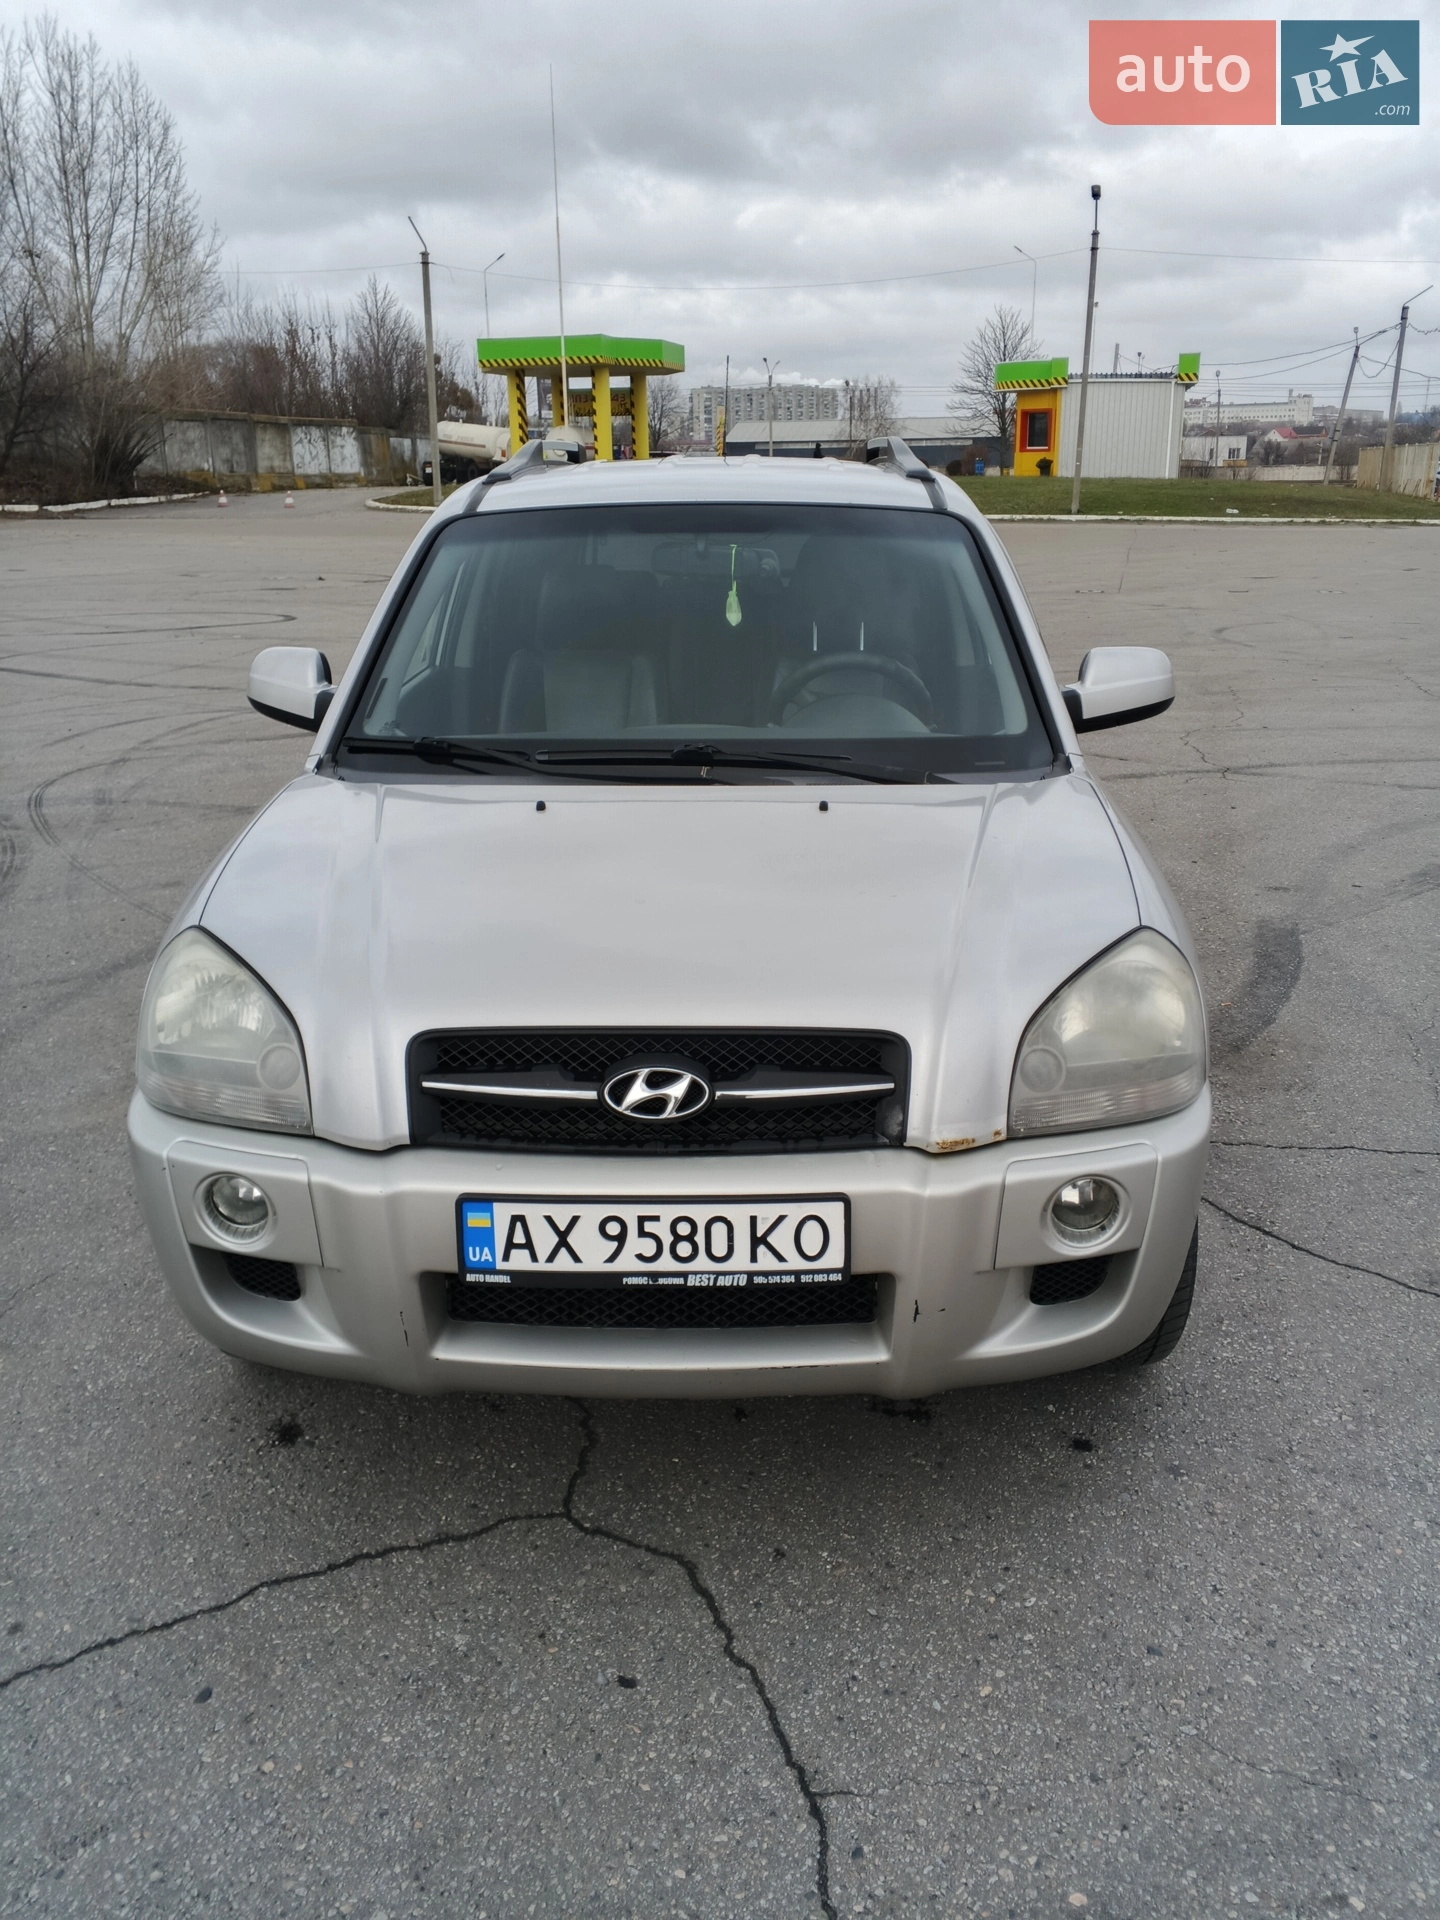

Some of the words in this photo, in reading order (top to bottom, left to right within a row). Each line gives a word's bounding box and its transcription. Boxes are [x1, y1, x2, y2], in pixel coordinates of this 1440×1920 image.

[501, 1214, 584, 1264] AX
[598, 1214, 735, 1264] 9580
[749, 1213, 831, 1263] KO
[468, 1246, 493, 1263] UA
[466, 1273, 485, 1282] AUTO
[622, 1276, 648, 1285] POMOC
[687, 1274, 716, 1287] BEST
[716, 1273, 748, 1286] AUTO
